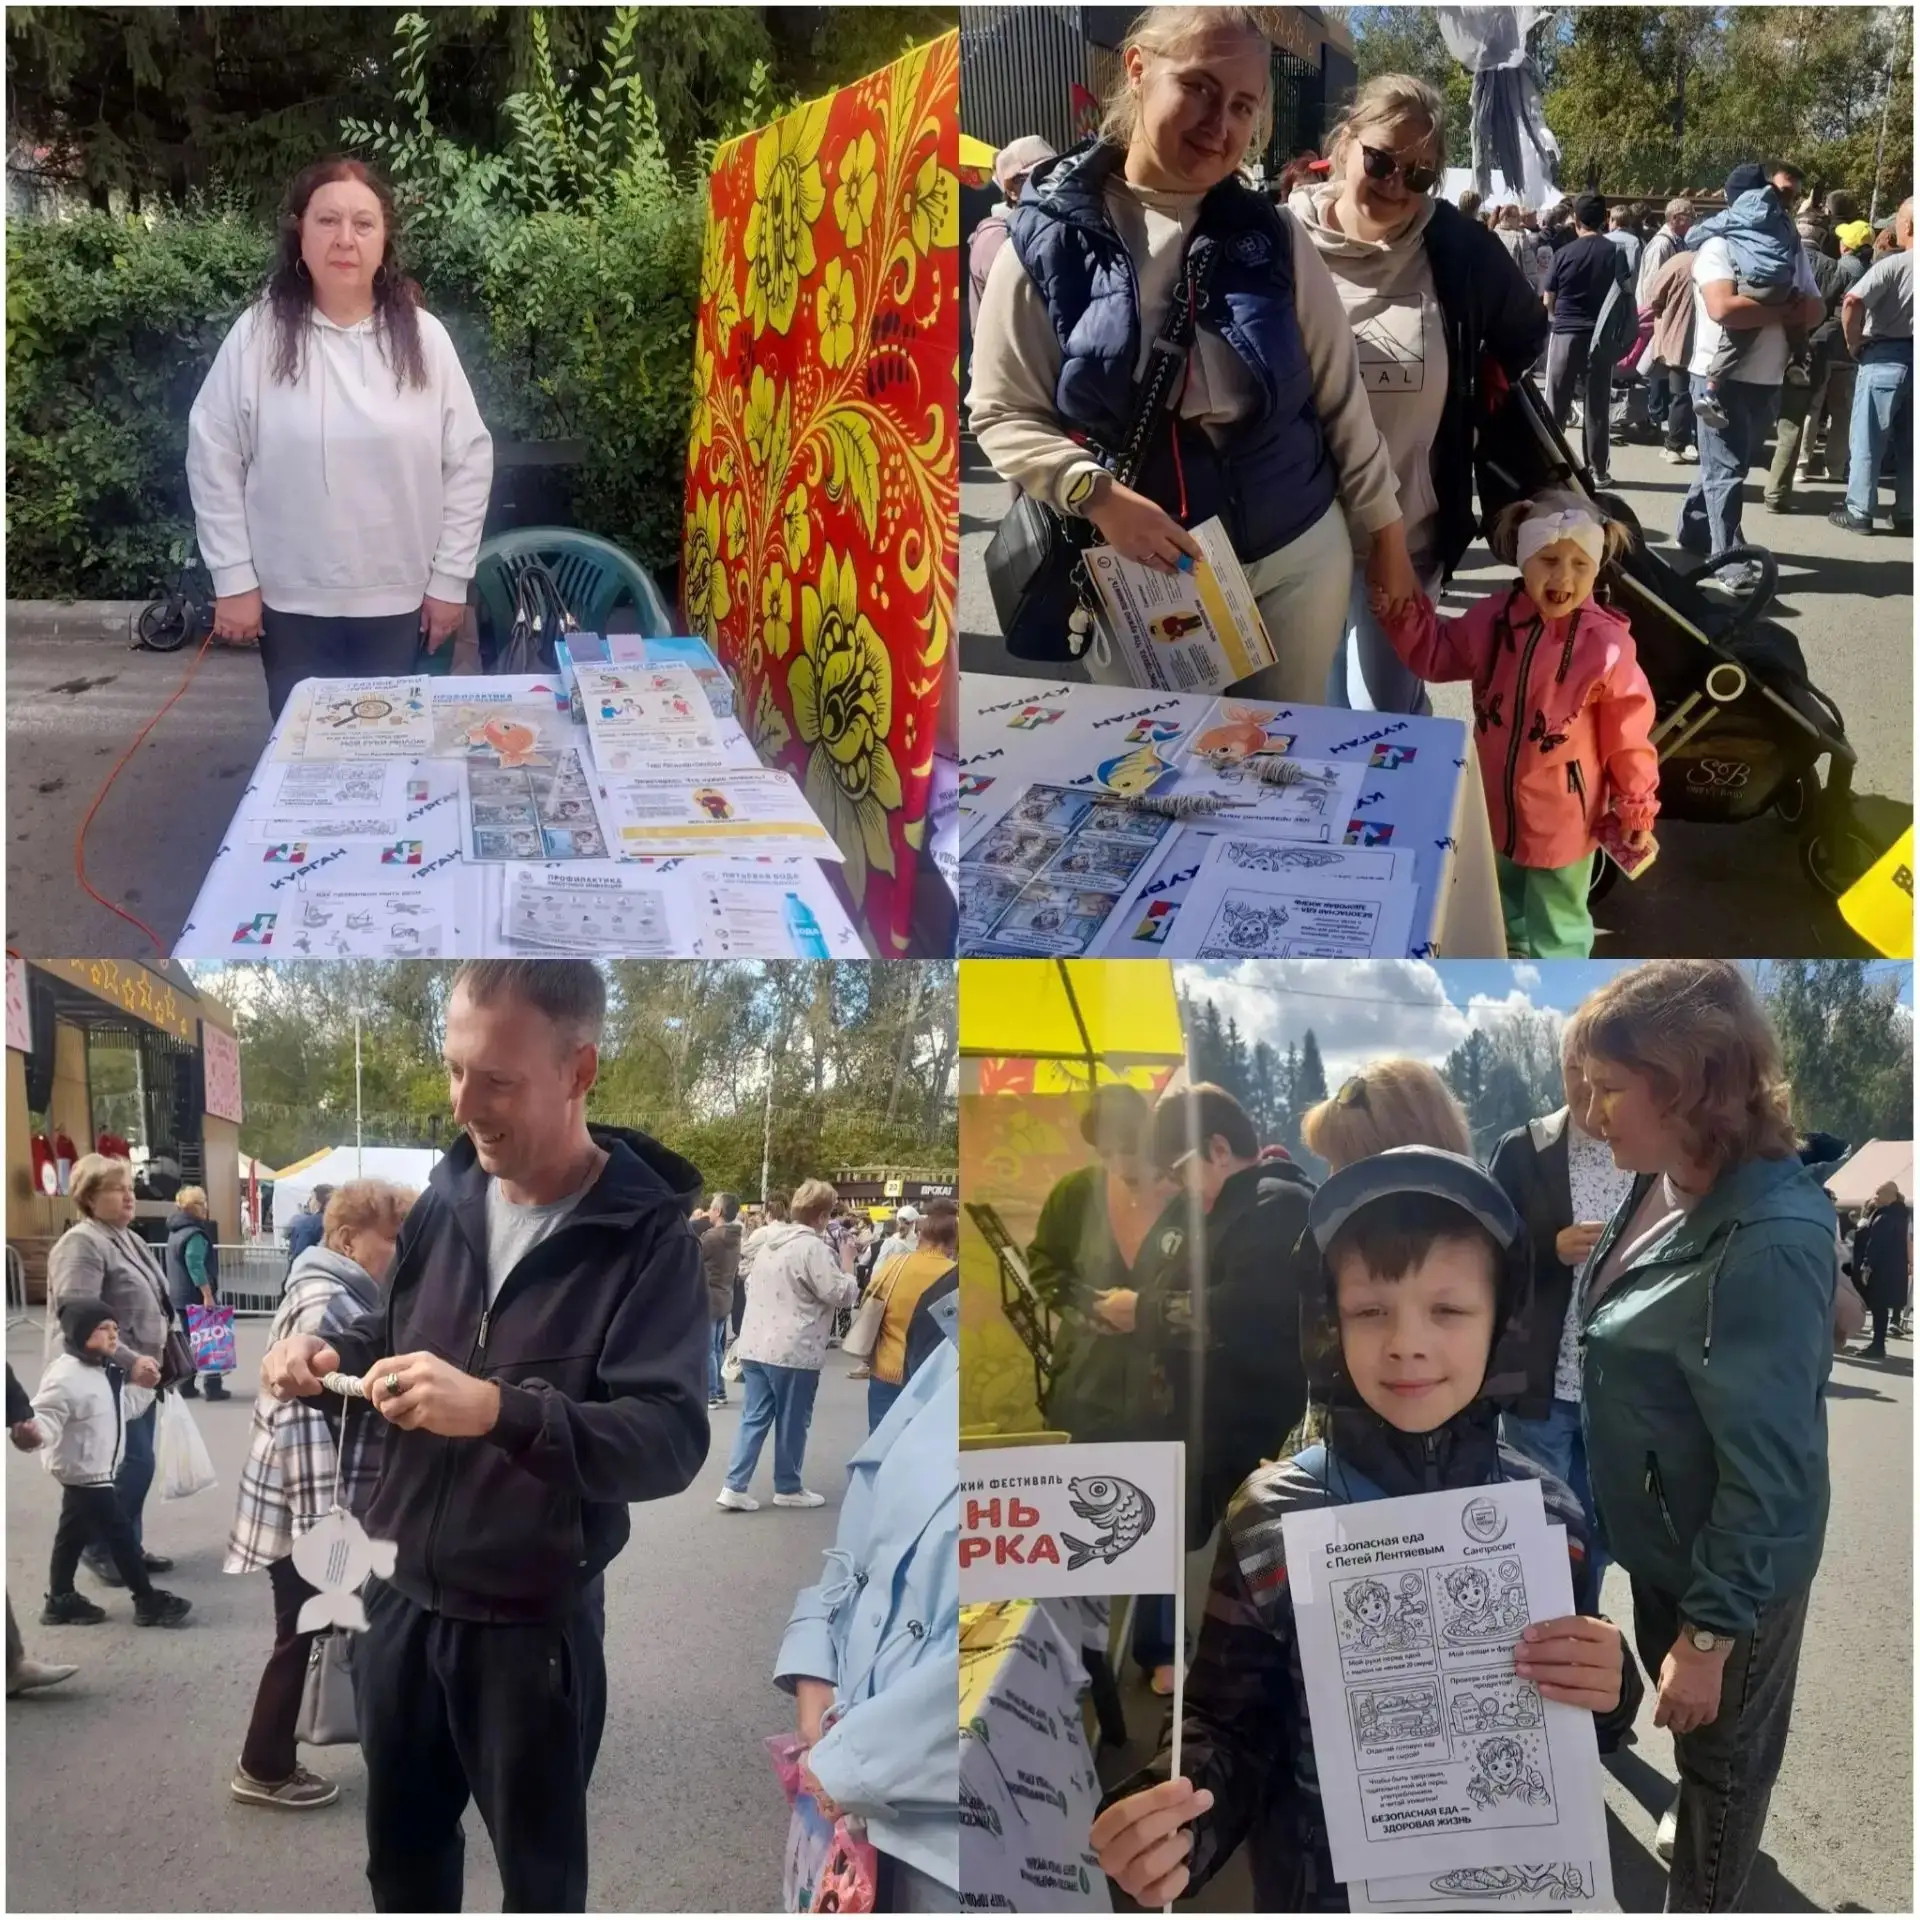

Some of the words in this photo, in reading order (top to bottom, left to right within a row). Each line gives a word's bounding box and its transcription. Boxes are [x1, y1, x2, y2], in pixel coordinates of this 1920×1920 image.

[977, 686, 1070, 716] КУРГАН
[1091, 699, 1181, 729] КУРГАН
[1329, 721, 1409, 754] КУРГАН
[271, 848, 348, 890] КУРГАН
[411, 849, 463, 880] РГАН
[989, 1475, 1064, 1490] ФЕСТИВАЛЬ
[959, 1534, 1061, 1569] РКА
[1326, 1536, 1399, 1555] Безопасная
[1401, 1533, 1425, 1544] еда
[1326, 1560, 1333, 1569] с
[1335, 1553, 1372, 1568] Петей
[1375, 1544, 1446, 1562] Лентяевым
[1463, 1542, 1517, 1556] Санпросвет
[1371, 1808, 1437, 1824] БЕЗОПАСНАЯ
[1439, 1805, 1459, 1815] ЕДА
[1383, 1819, 1435, 1834] ЗДОРОВАЯ
[1437, 1815, 1472, 1827] ЖИЗНЬ
